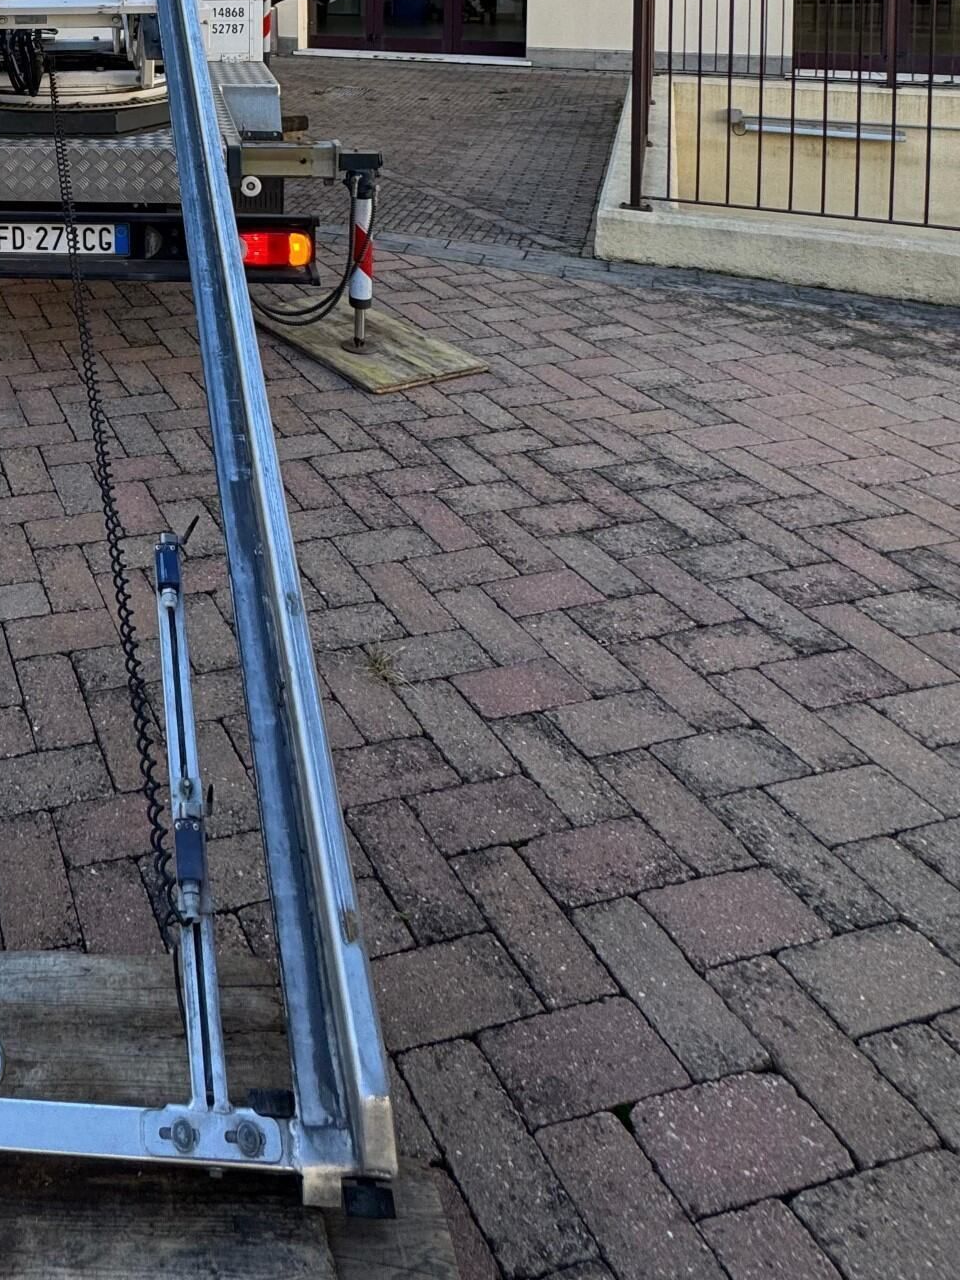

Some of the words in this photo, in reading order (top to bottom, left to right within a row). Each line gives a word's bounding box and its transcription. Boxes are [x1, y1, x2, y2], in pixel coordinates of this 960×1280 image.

[212, 7, 245, 18] 14868
[212, 23, 245, 35] 52787
[35, 226, 112, 252] 27CG
